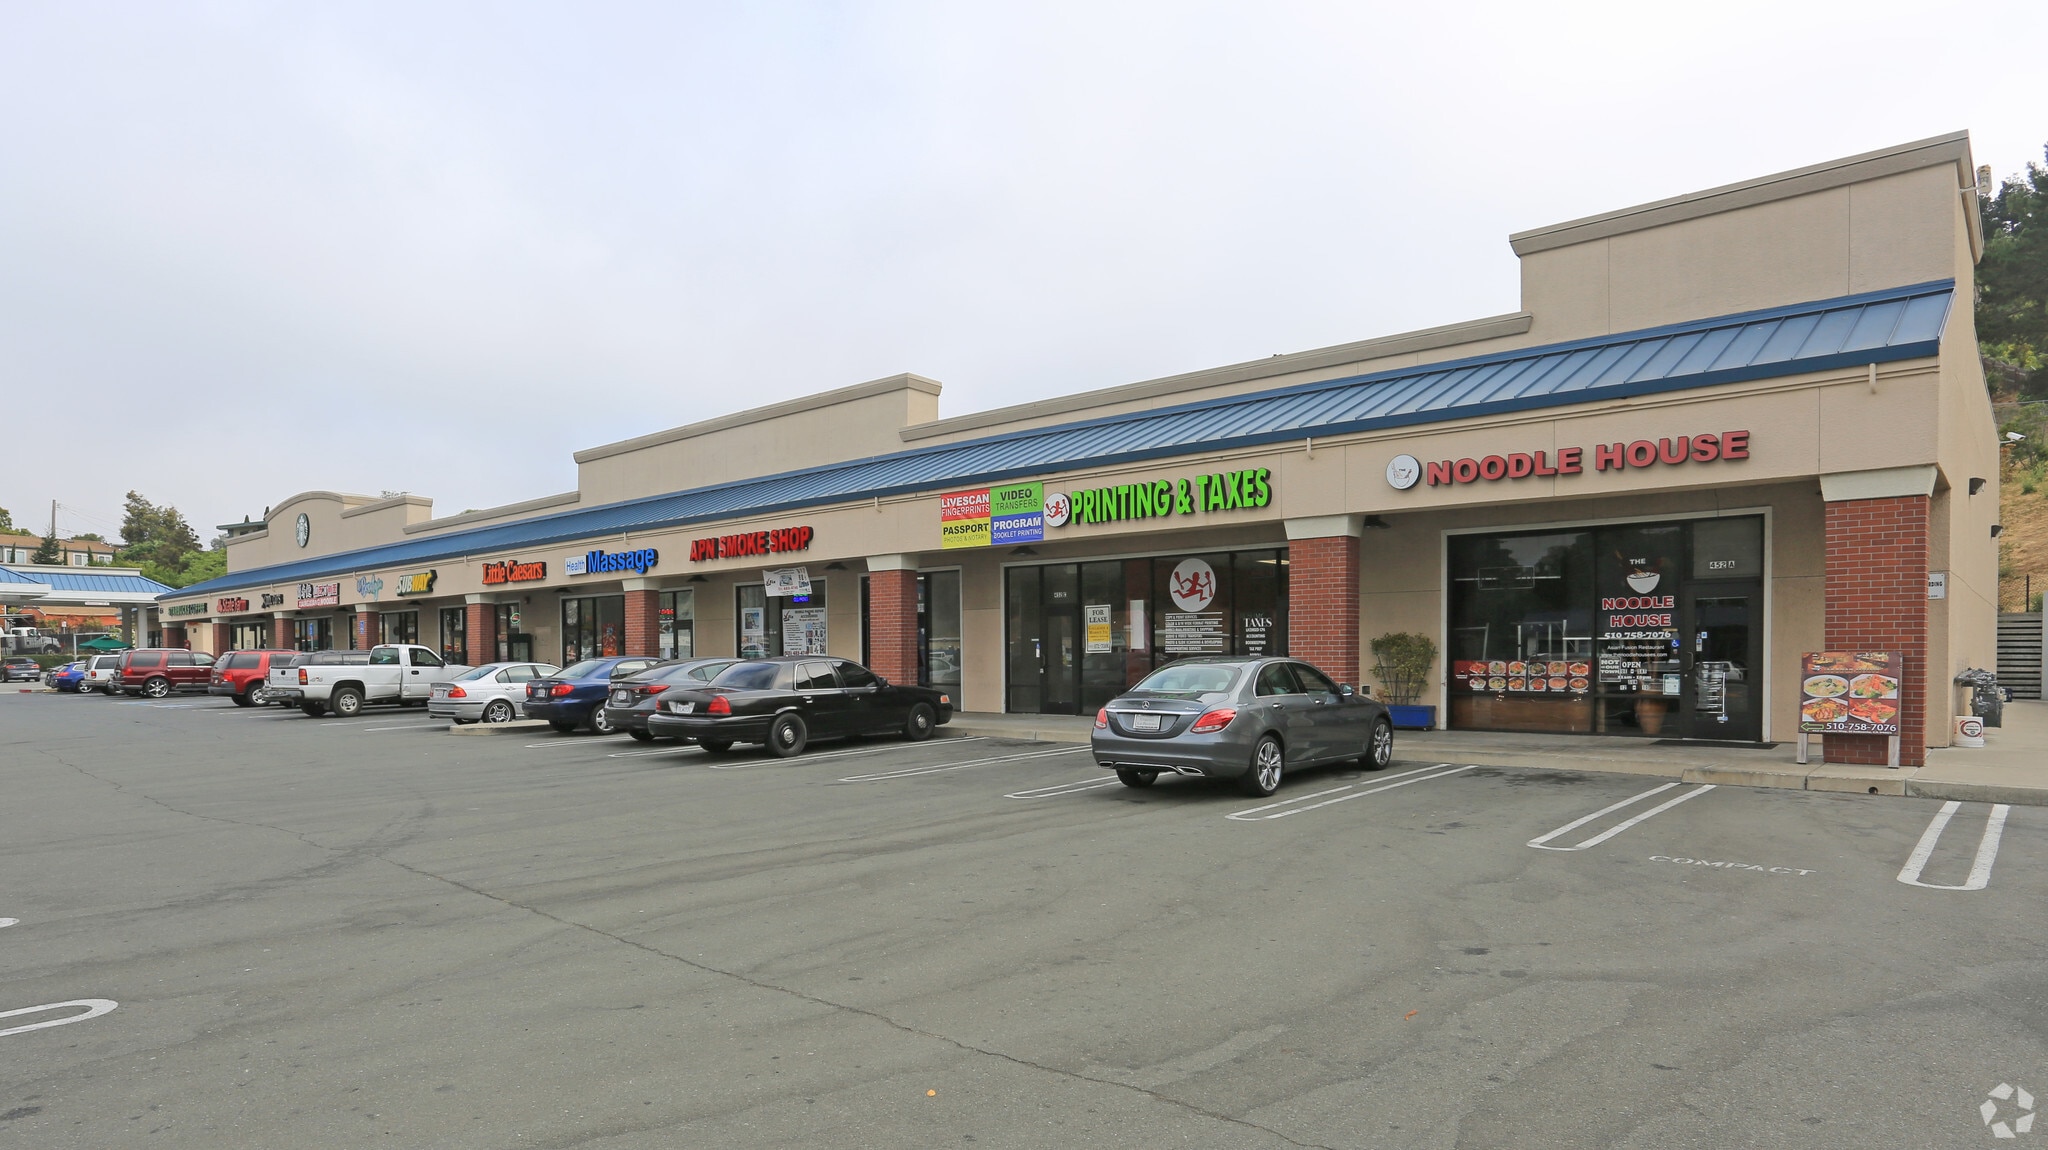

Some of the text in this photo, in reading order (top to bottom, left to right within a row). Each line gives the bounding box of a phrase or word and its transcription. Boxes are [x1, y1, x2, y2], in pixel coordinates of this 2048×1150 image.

[1427, 430, 1750, 486] NOODLE HOUSE
[942, 494, 990, 508] LIVESCAN
[1000, 488, 1032, 501] VIDEO
[1071, 467, 1271, 525] PRINTING & TAXES
[942, 504, 990, 517] FINGERPRINTS
[996, 498, 1038, 511] TRANSFERS
[943, 523, 989, 535] PASSPORT
[994, 517, 1042, 530] PROGRAM
[994, 528, 1042, 539] BOOKLET PRINTING
[690, 526, 811, 561] APN SMOKE SHOP
[566, 559, 586, 574] Health
[587, 548, 657, 575] Massage
[482, 560, 545, 585] Little Caesars
[397, 572, 433, 594] SUBWAY
[1602, 596, 1674, 610] NOODLE
[1244, 618, 1272, 627] TAXES
[1610, 614, 1672, 627] HOUSE
[1826, 723, 1897, 732] 510-758-7076
[1649, 855, 1817, 876] COMPACT
